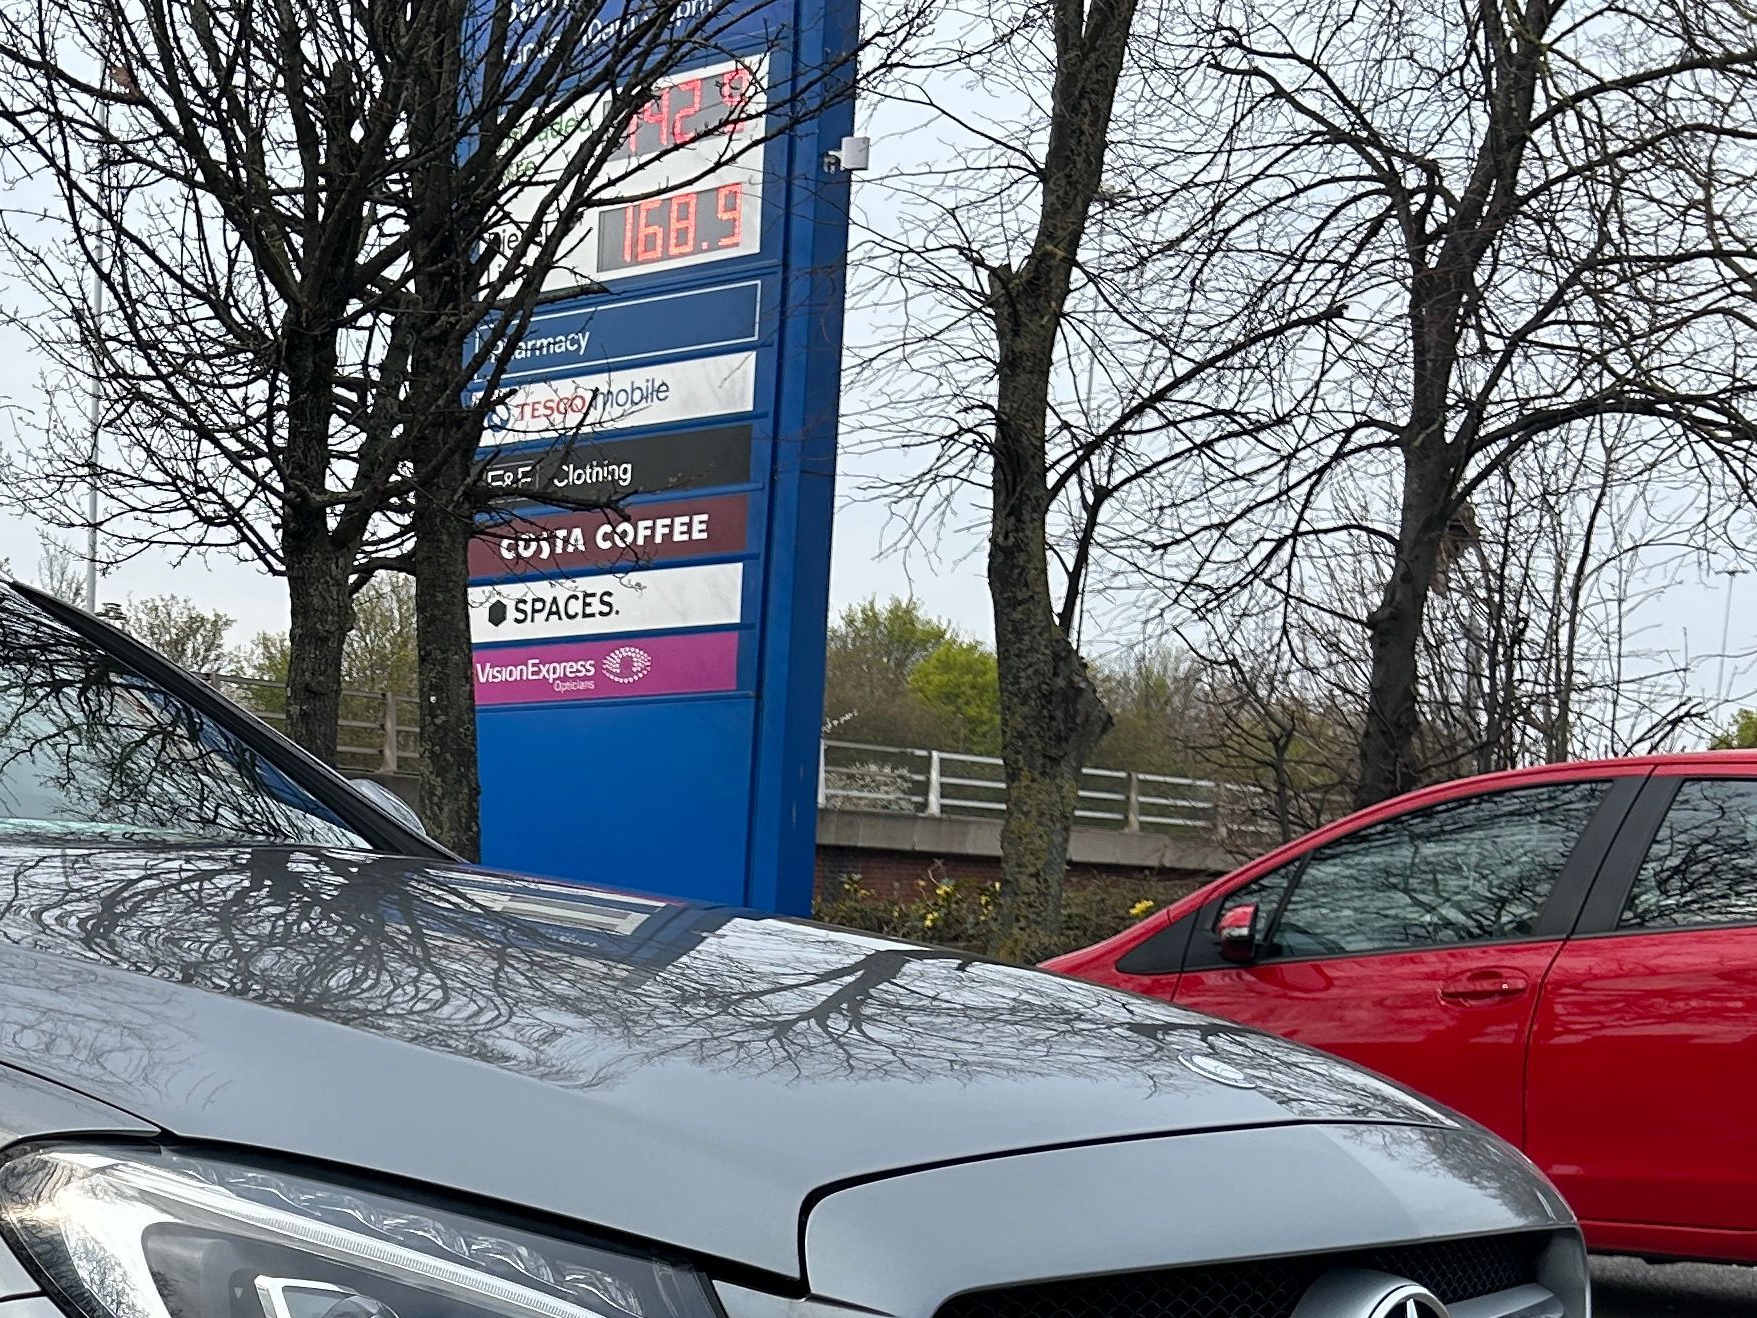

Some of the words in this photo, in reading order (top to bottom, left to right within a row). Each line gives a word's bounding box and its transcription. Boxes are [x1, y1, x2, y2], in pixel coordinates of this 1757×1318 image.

[623, 182, 743, 262] 168.9
[491, 331, 590, 362] Parmacy
[516, 394, 586, 421] TESCO
[593, 377, 670, 411] mobile
[553, 459, 633, 487] Clothing
[499, 527, 585, 560] COSTA
[595, 513, 709, 550] COFFEE
[476, 659, 595, 684] VisionExpress
